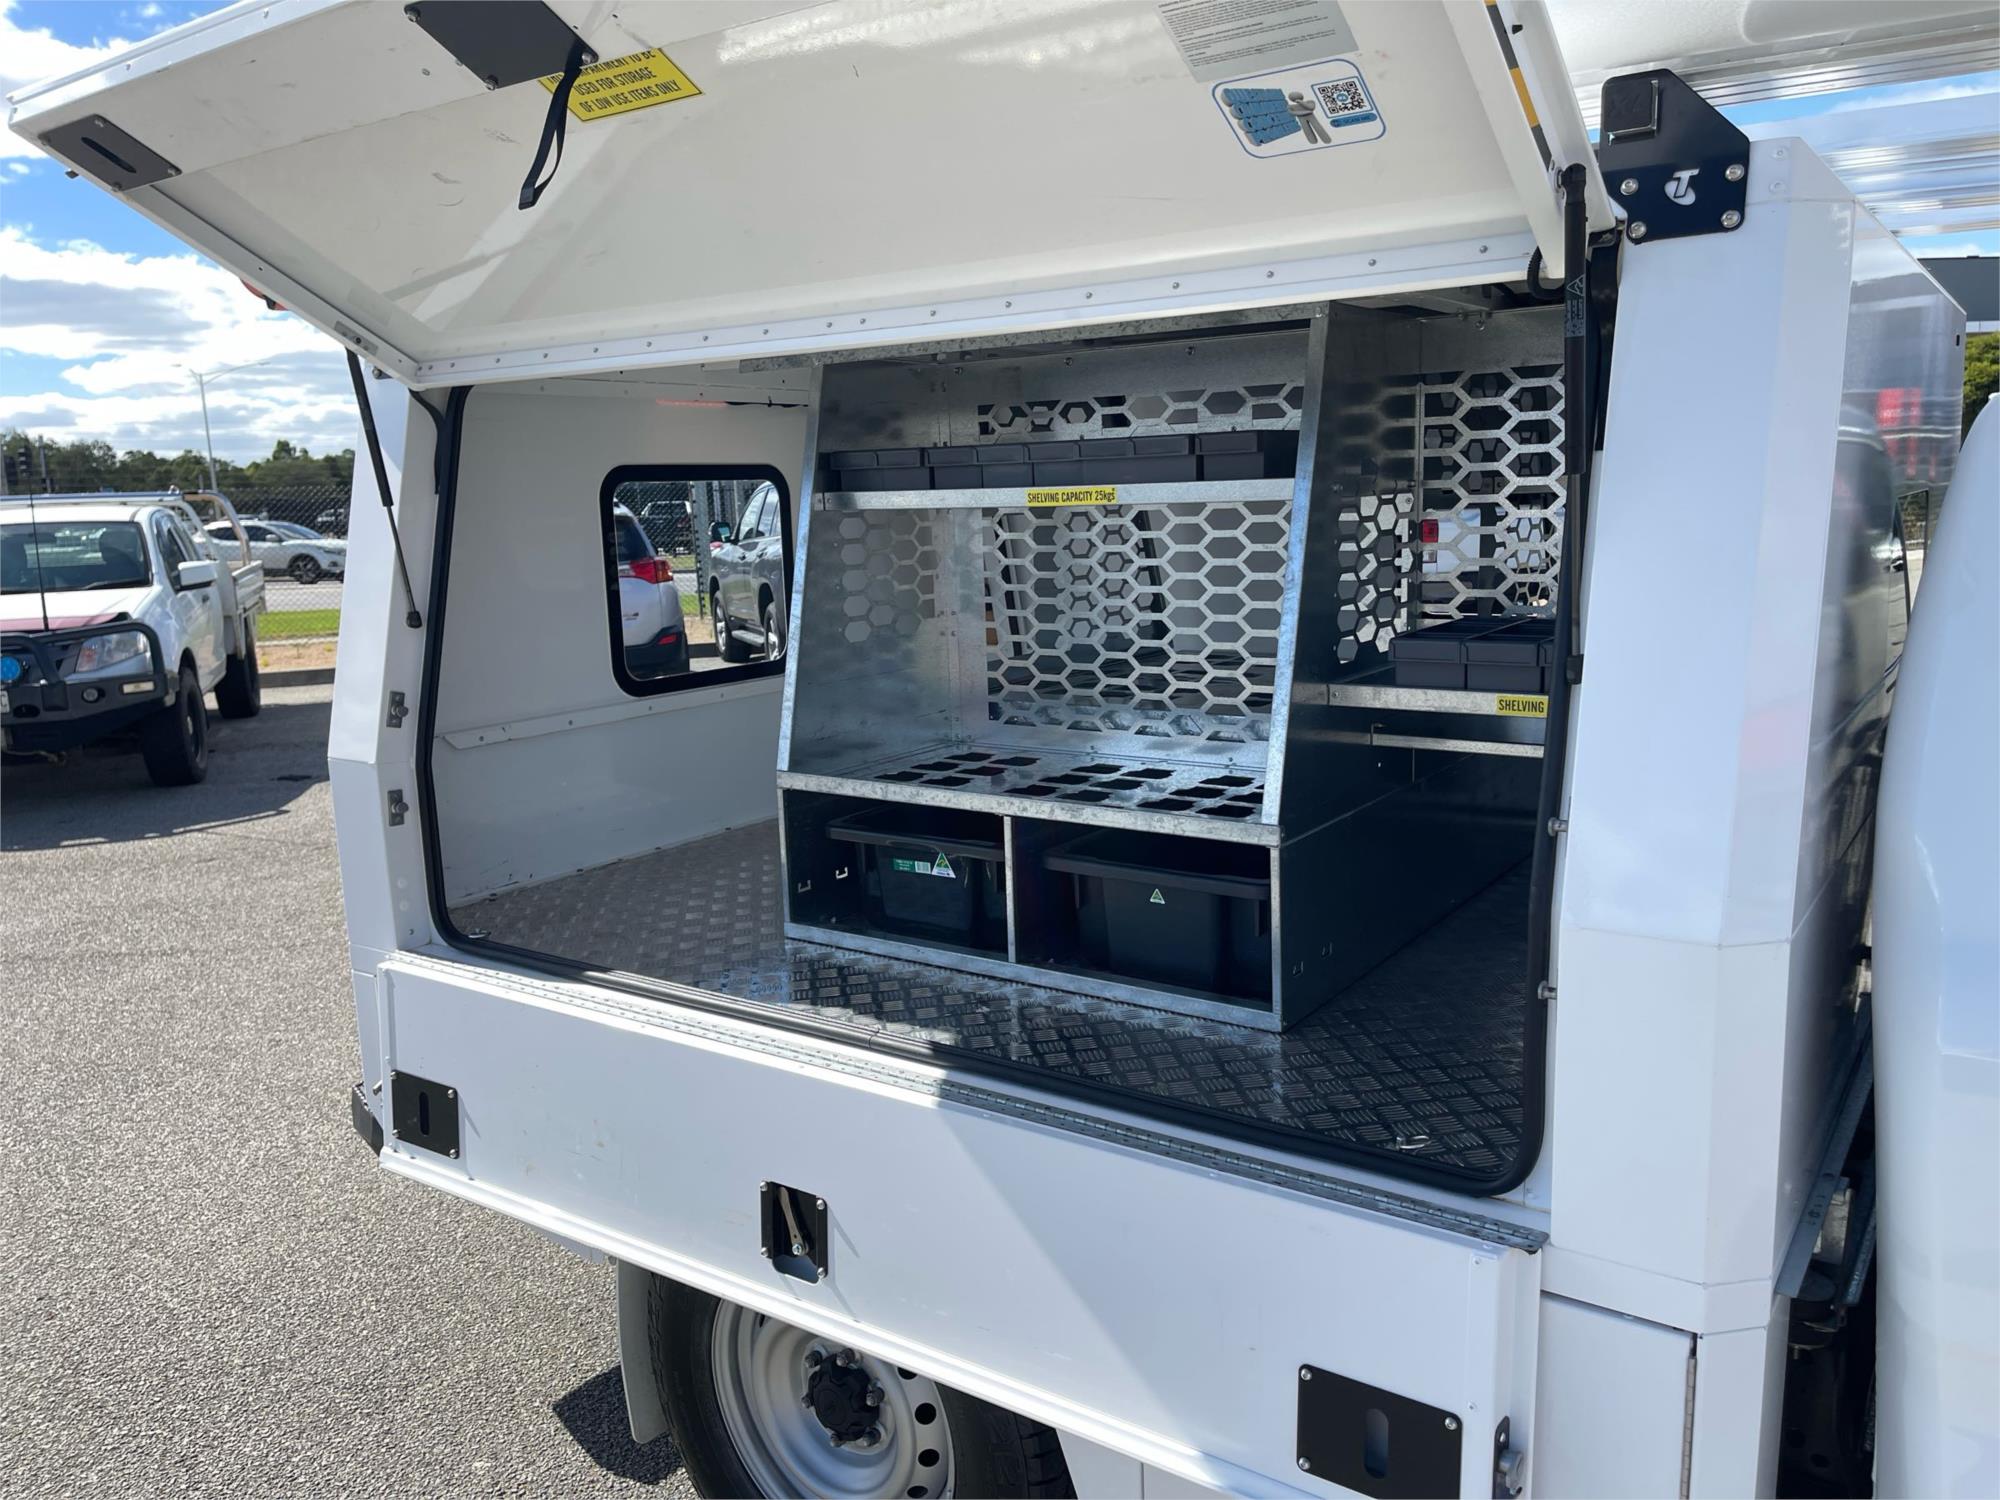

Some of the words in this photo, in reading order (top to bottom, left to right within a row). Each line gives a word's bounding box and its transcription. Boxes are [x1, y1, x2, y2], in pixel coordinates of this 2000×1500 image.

[573, 81, 600, 96] USED
[596, 77, 618, 91] FOR
[613, 66, 657, 86] STORAGE
[579, 101, 595, 113] OF
[591, 96, 614, 110] LOW
[610, 92, 633, 106] USE
[628, 85, 659, 101] ITEMS
[655, 79, 682, 95] ONLY
[1027, 492, 1060, 504] SHELVING
[1061, 490, 1093, 503] CAPACITY
[1094, 489, 1116, 503] 25kgs
[1498, 698, 1545, 714] SHELVING
